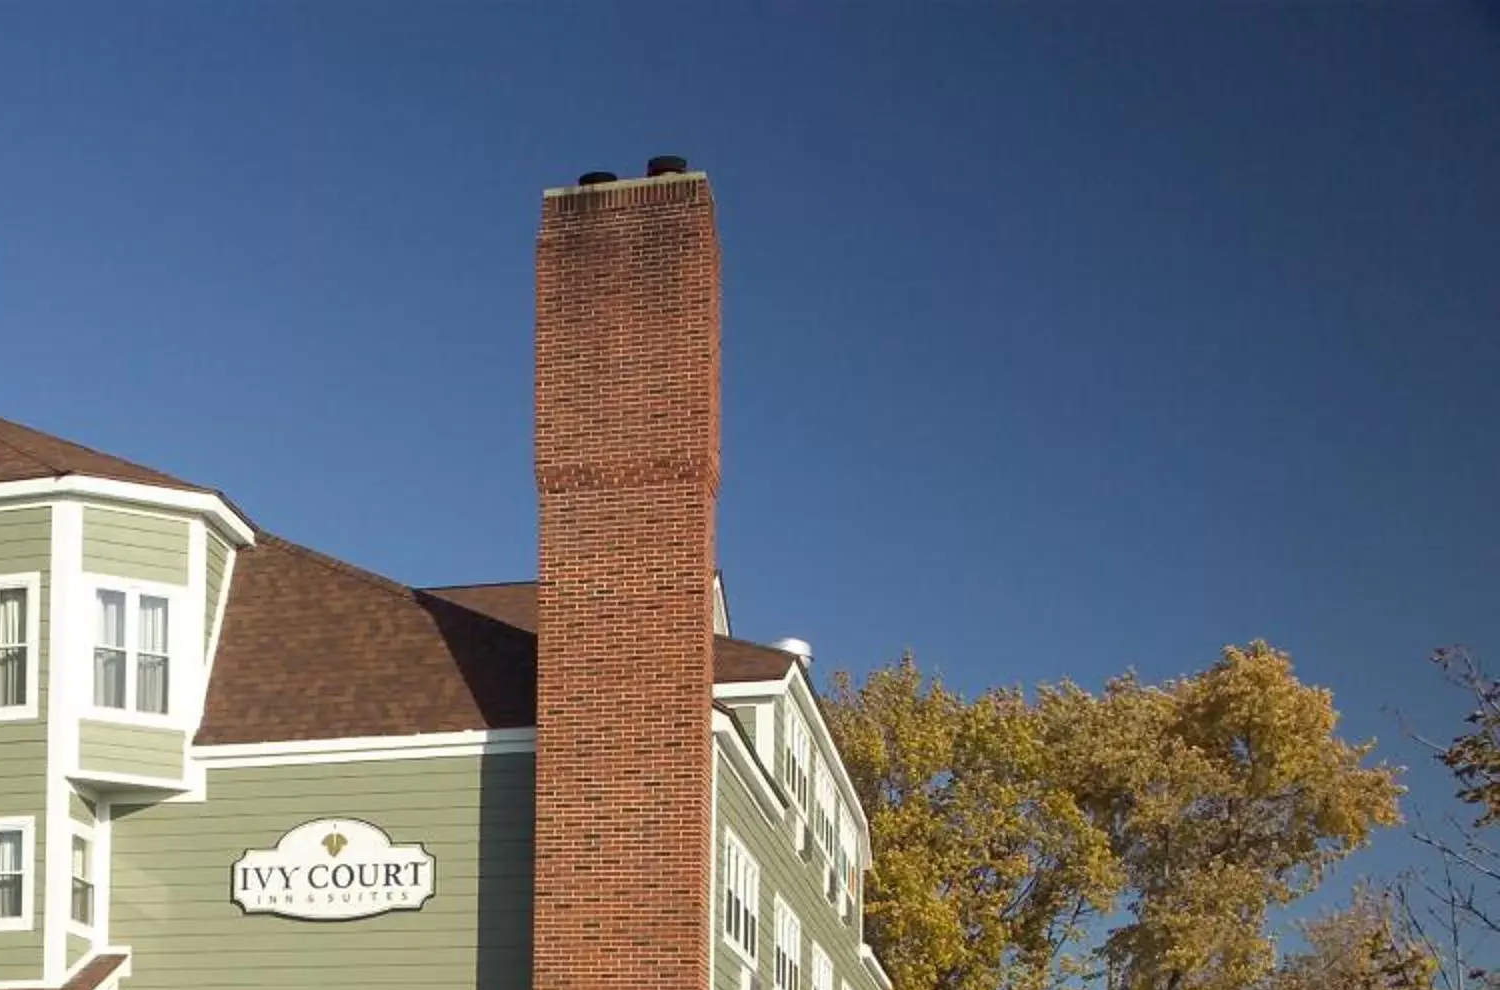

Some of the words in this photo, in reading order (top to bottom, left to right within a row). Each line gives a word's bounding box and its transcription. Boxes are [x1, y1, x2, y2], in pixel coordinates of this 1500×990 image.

[240, 866, 301, 891] IVY
[307, 861, 429, 889] COURT
[257, 893, 294, 905] INN
[307, 893, 316, 903] &
[327, 891, 409, 903] SUITES
